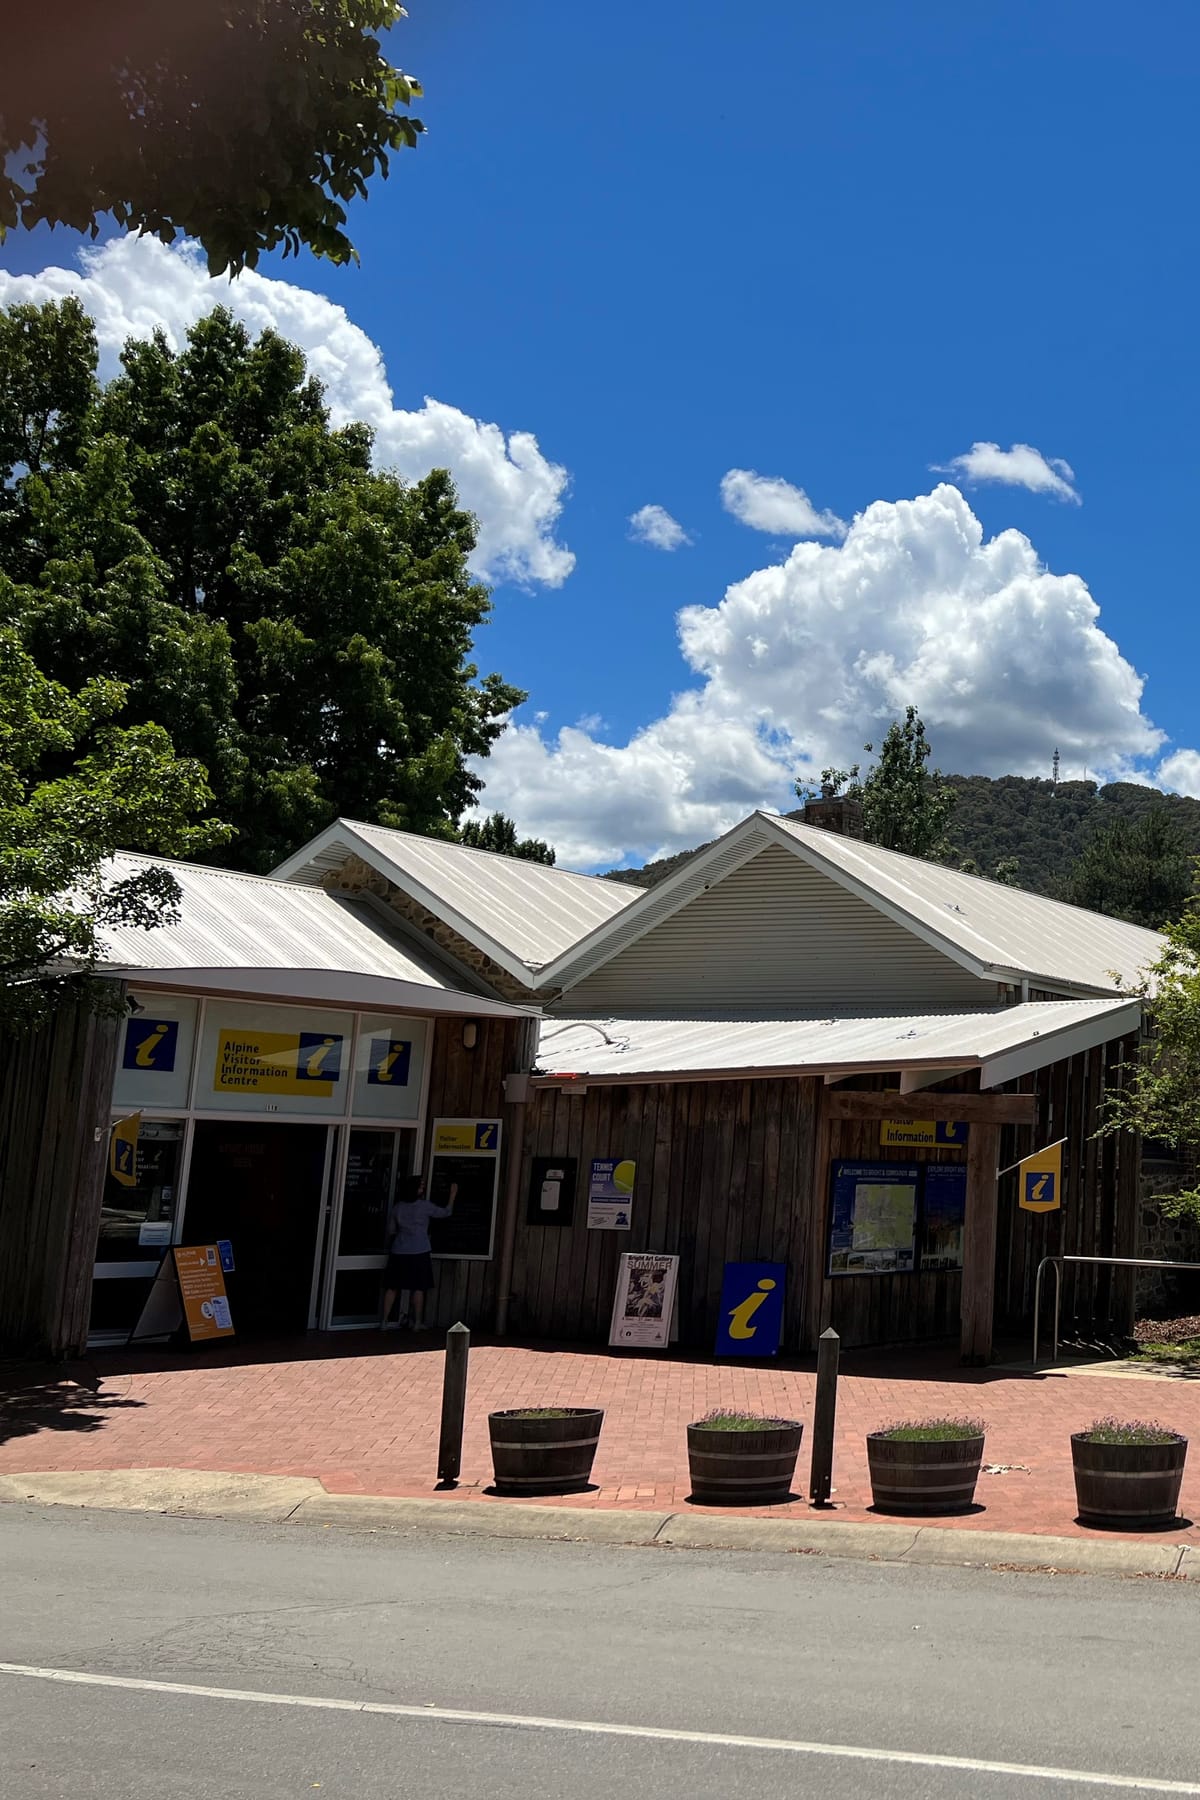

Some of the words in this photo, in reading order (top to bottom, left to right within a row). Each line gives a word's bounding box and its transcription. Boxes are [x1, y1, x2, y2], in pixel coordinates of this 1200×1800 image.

[224, 1041, 260, 1054] Alpine
[224, 1052, 262, 1065] Visitor
[222, 1064, 288, 1078] Information
[220, 1074, 258, 1086] Centre
[888, 1128, 933, 1142] Information
[592, 1162, 614, 1172] TENNIS
[592, 1173, 611, 1182] COURT
[628, 1261, 672, 1270] SUMMER
